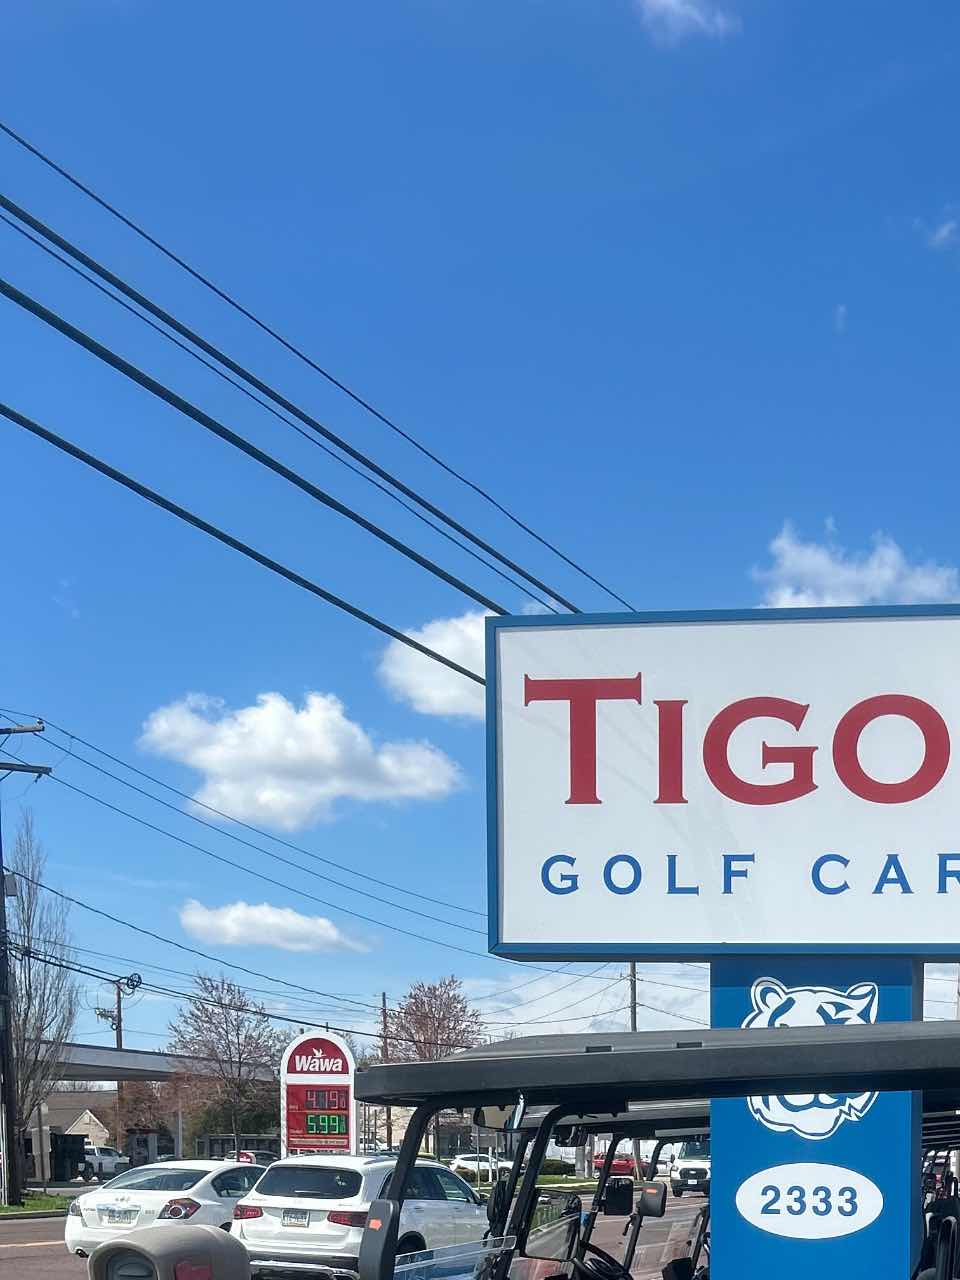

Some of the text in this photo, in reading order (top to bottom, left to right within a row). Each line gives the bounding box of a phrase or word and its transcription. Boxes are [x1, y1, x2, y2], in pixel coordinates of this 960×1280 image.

[540, 852, 755, 897] GOLF
[294, 1055, 343, 1072] Wawa
[760, 1184, 859, 1217] 2333
